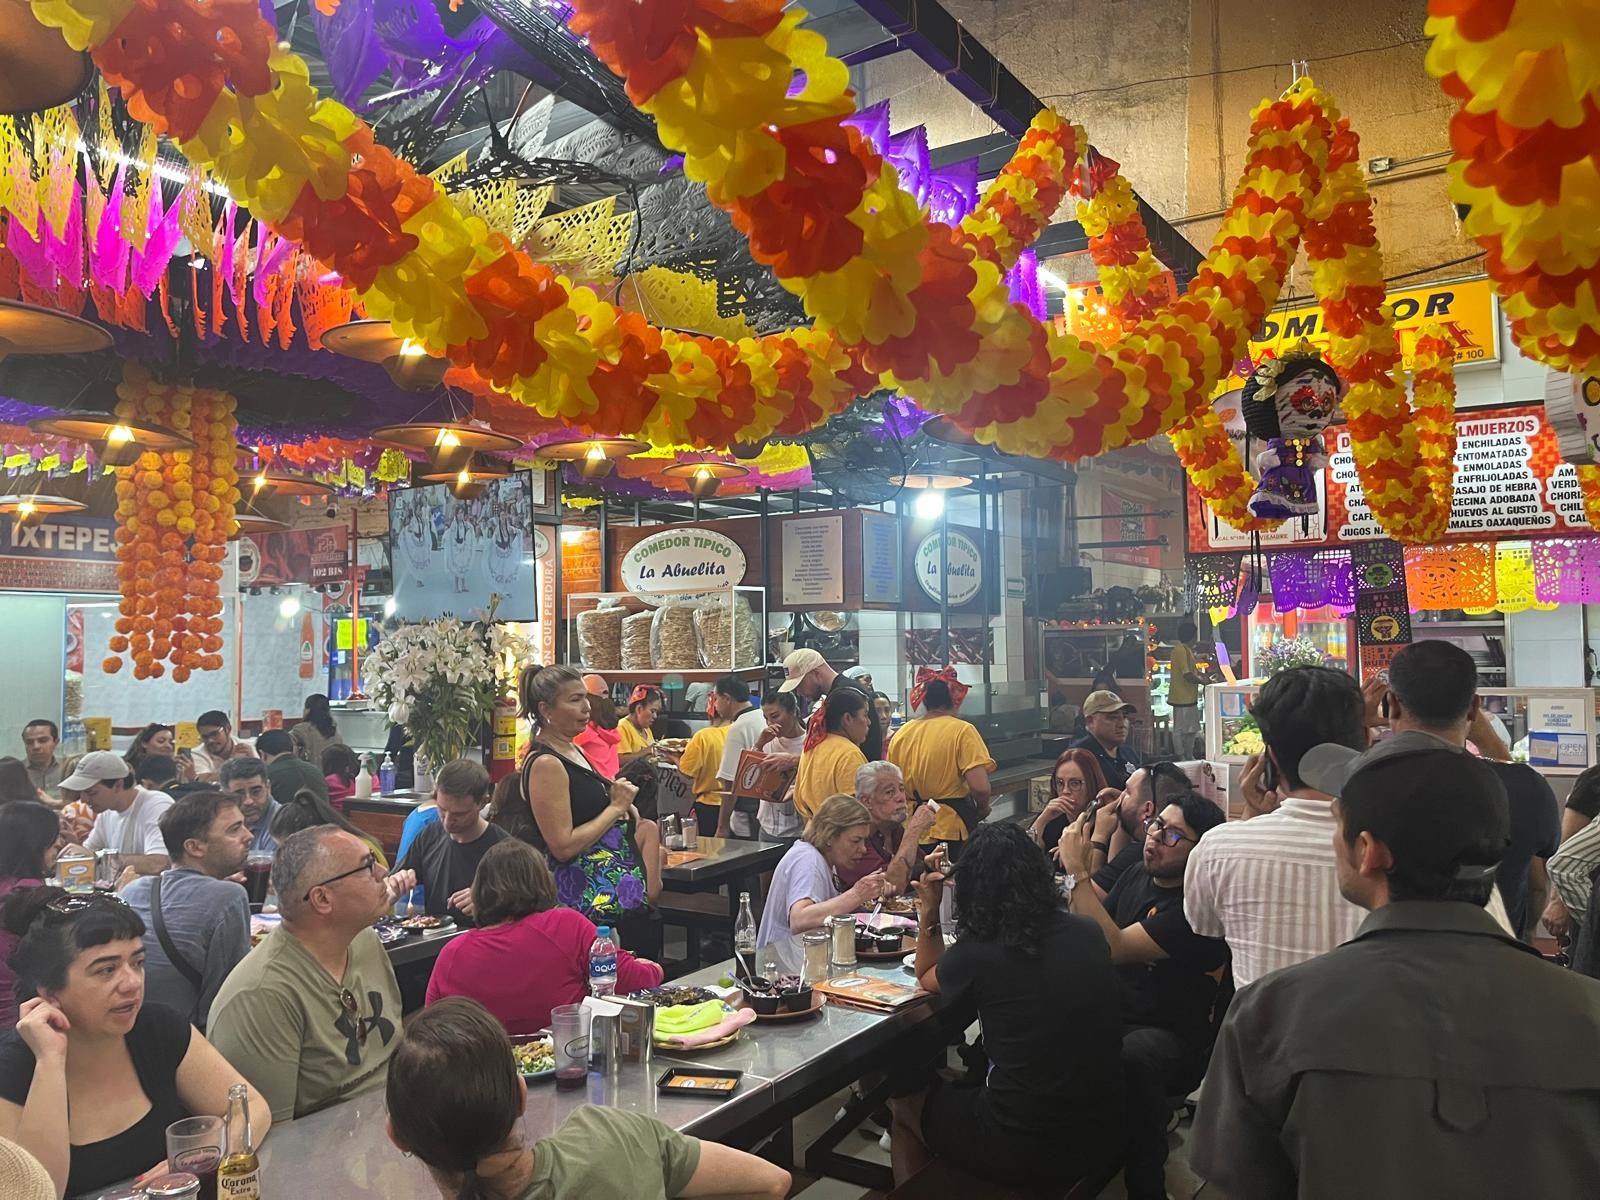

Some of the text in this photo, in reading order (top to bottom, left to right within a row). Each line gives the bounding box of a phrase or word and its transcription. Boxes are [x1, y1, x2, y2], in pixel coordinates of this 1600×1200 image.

[1252, 291, 1454, 342] OMOR
[1466, 349, 1484, 358] 100
[1458, 420, 1535, 437] LMUERZOS
[1462, 437, 1522, 449] ENCHILADAS
[1457, 448, 1528, 461] ENTOMATADAS
[1463, 460, 1522, 472] ENMOLADAS
[1558, 468, 1577, 477] AM
[1458, 471, 1528, 483] ENFRIJOLADAS
[1453, 482, 1537, 495] ASAJO DE HEBRA
[1552, 479, 1581, 489] VERD
[1452, 494, 1536, 507] CECINA ADOBADA
[1551, 491, 1584, 501] CHORI
[1349, 499, 1367, 507] CHA
[1560, 502, 1585, 511] CHIL
[1451, 505, 1538, 518] HUEVOS AL GUSTO
[1446, 515, 1551, 529] MALES OAXAQUEÑOS
[1569, 514, 1588, 523] CAL
[1342, 527, 1371, 536] JUGOS
[634, 537, 732, 563] COMEDOR TIPICO
[923, 537, 978, 562] COMOR TIPICO
[312, 567, 343, 577] 102 BIS
[640, 562, 726, 579] La Abuelita
[927, 561, 975, 577] La buelita
[544, 559, 553, 616] PERDURA
[544, 618, 552, 645] QUE
[221, 1175, 257, 1190] Corona
[231, 1187, 251, 1195] Extra
